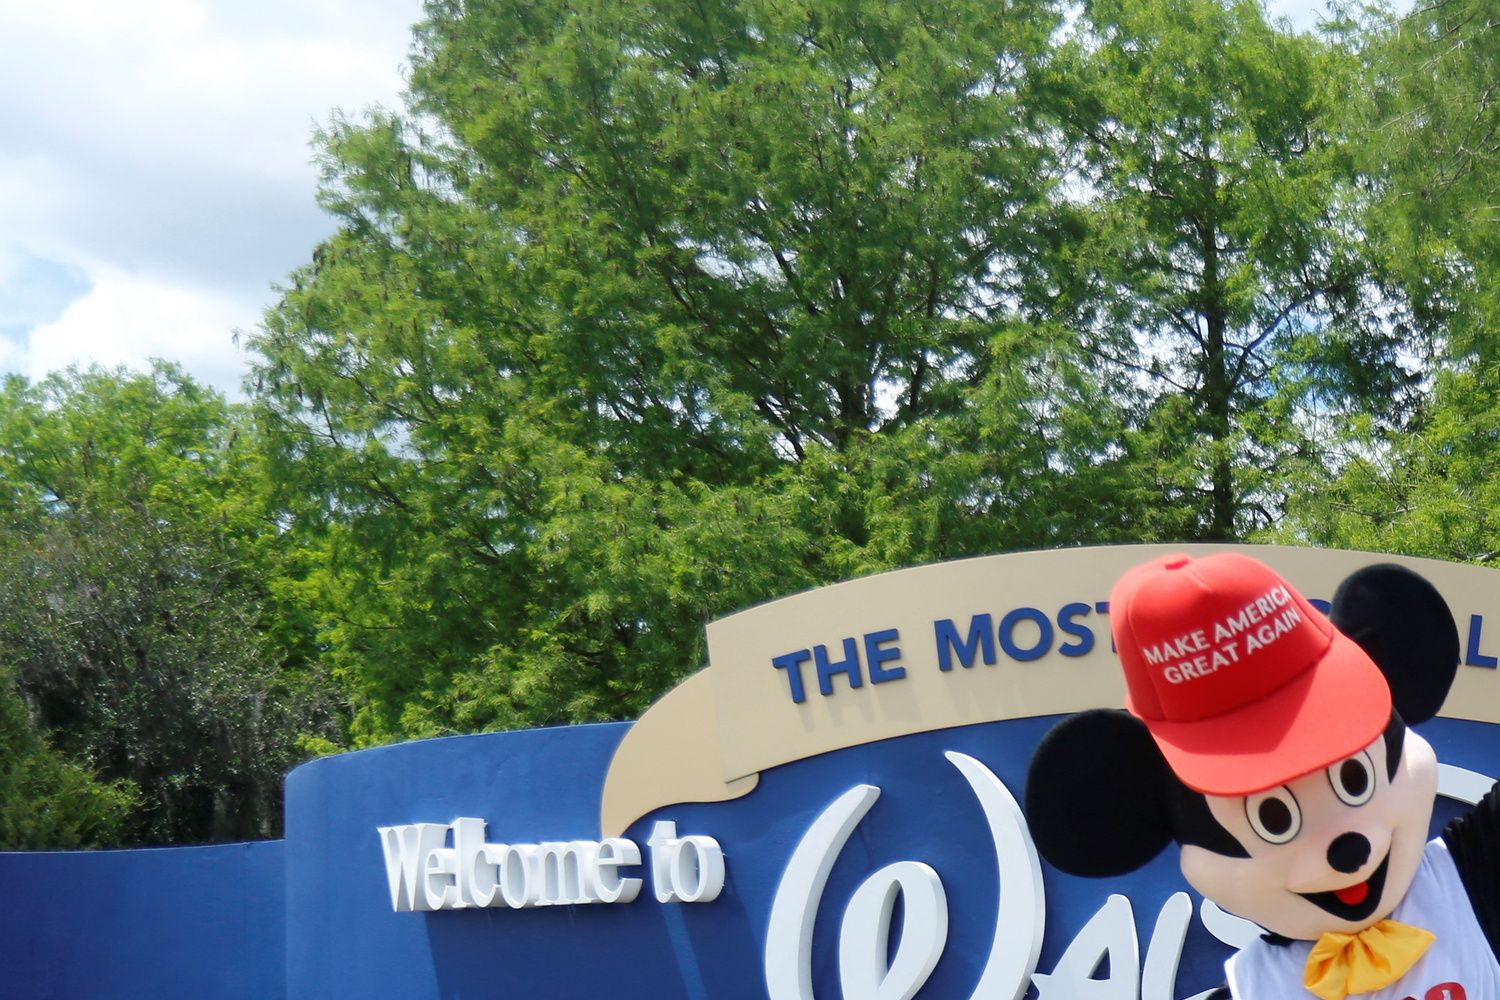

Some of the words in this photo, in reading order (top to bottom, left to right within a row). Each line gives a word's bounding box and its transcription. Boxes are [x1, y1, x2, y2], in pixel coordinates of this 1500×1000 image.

[771, 628, 906, 704] THE
[934, 601, 1118, 672] MOS
[1142, 629, 1211, 665] MAKE
[1214, 584, 1293, 644] AMERICA
[1163, 642, 1240, 684] GREAT
[1247, 607, 1302, 655] AGAIN
[378, 817, 643, 912] Welcome
[647, 821, 725, 903] to
